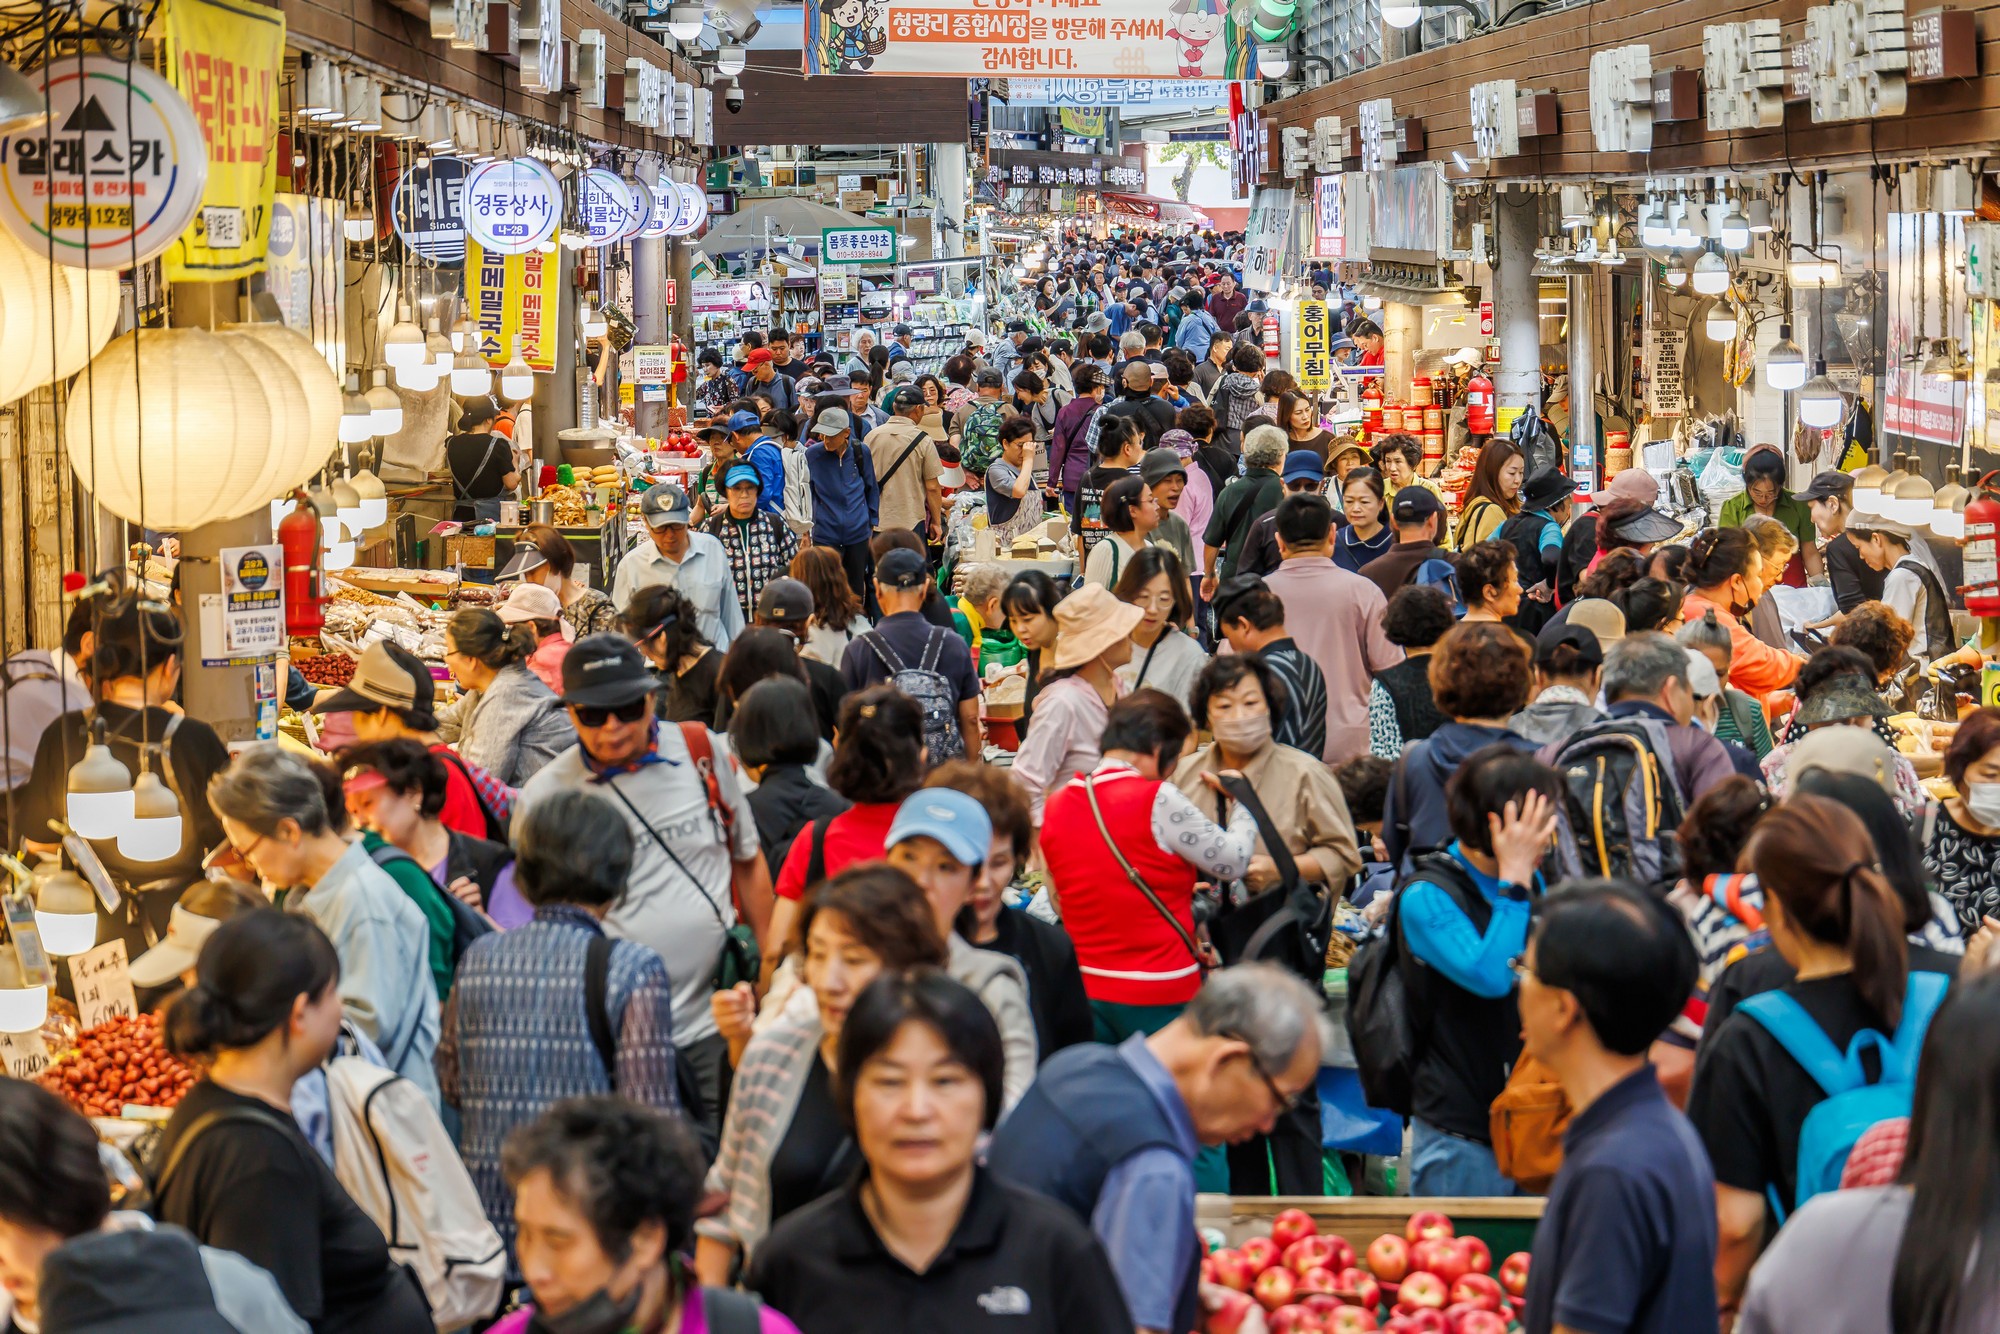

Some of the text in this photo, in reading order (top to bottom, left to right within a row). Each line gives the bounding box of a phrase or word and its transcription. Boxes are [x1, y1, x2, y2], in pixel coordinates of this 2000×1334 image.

[893, 12, 1164, 41] 청량리 종합시장을 방문해 주셔서
[981, 47, 1078, 71] 감사합니다.
[14, 137, 165, 176] 알래스카
[474, 194, 549, 217] 경동상사
[429, 222, 458, 231] Since
[498, 224, 524, 235] 나-28
[590, 227, 605, 235] -26
[829, 233, 889, 249] 몸愛좋은약초
[521, 295, 541, 360] 메밀국수
[1303, 305, 1325, 376] 홍어무침
[639, 366, 666, 375] 참여점포
